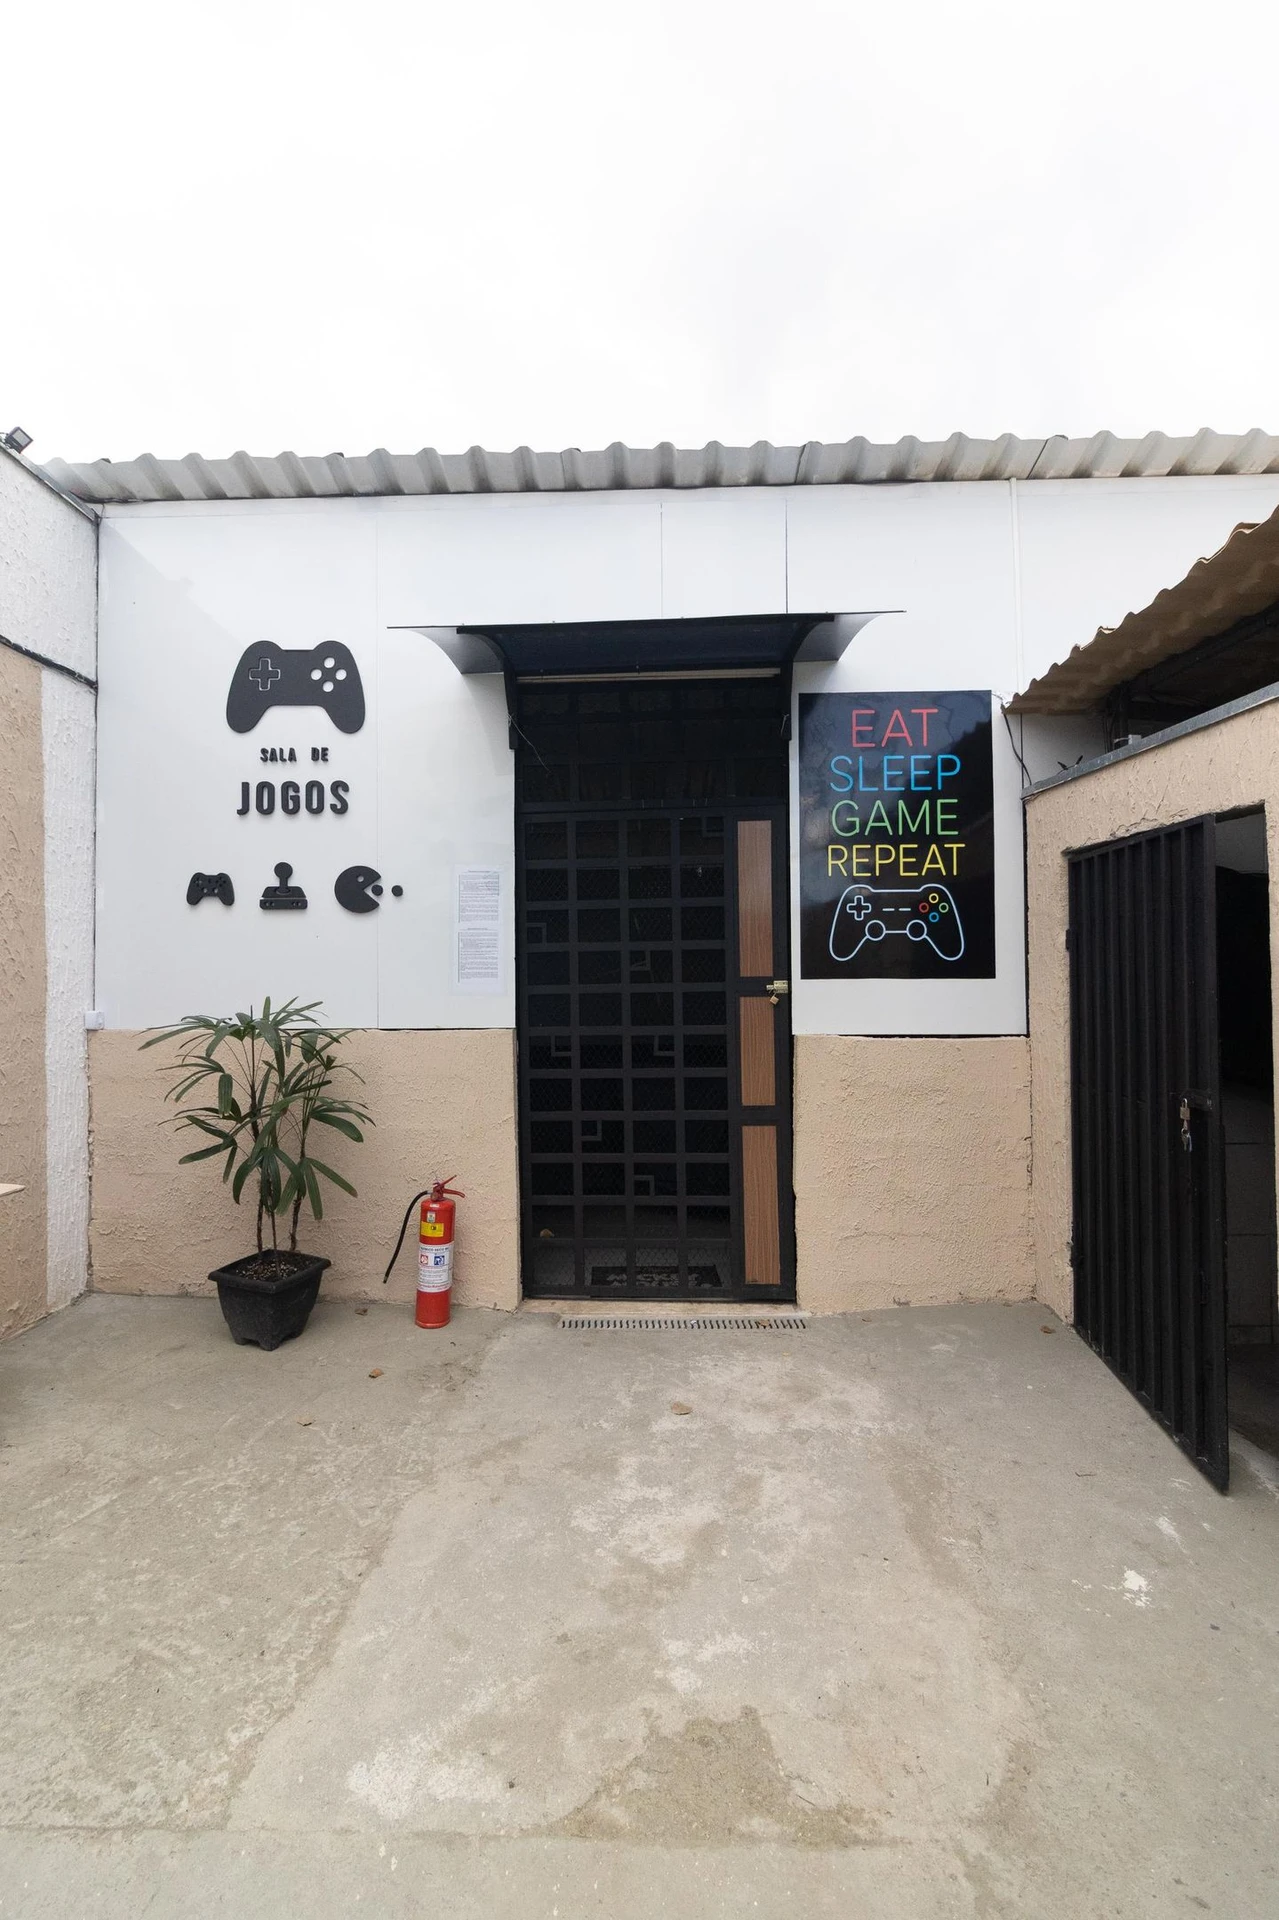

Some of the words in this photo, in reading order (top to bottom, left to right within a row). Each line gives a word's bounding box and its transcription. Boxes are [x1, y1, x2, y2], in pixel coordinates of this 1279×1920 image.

[851, 708, 938, 748] EAT
[259, 747, 298, 763] SALA
[310, 747, 329, 763] DE
[829, 754, 962, 793] SLEEP
[236, 780, 350, 816] JOGOS
[830, 798, 959, 837] GAME
[827, 843, 966, 877] REPEAT
